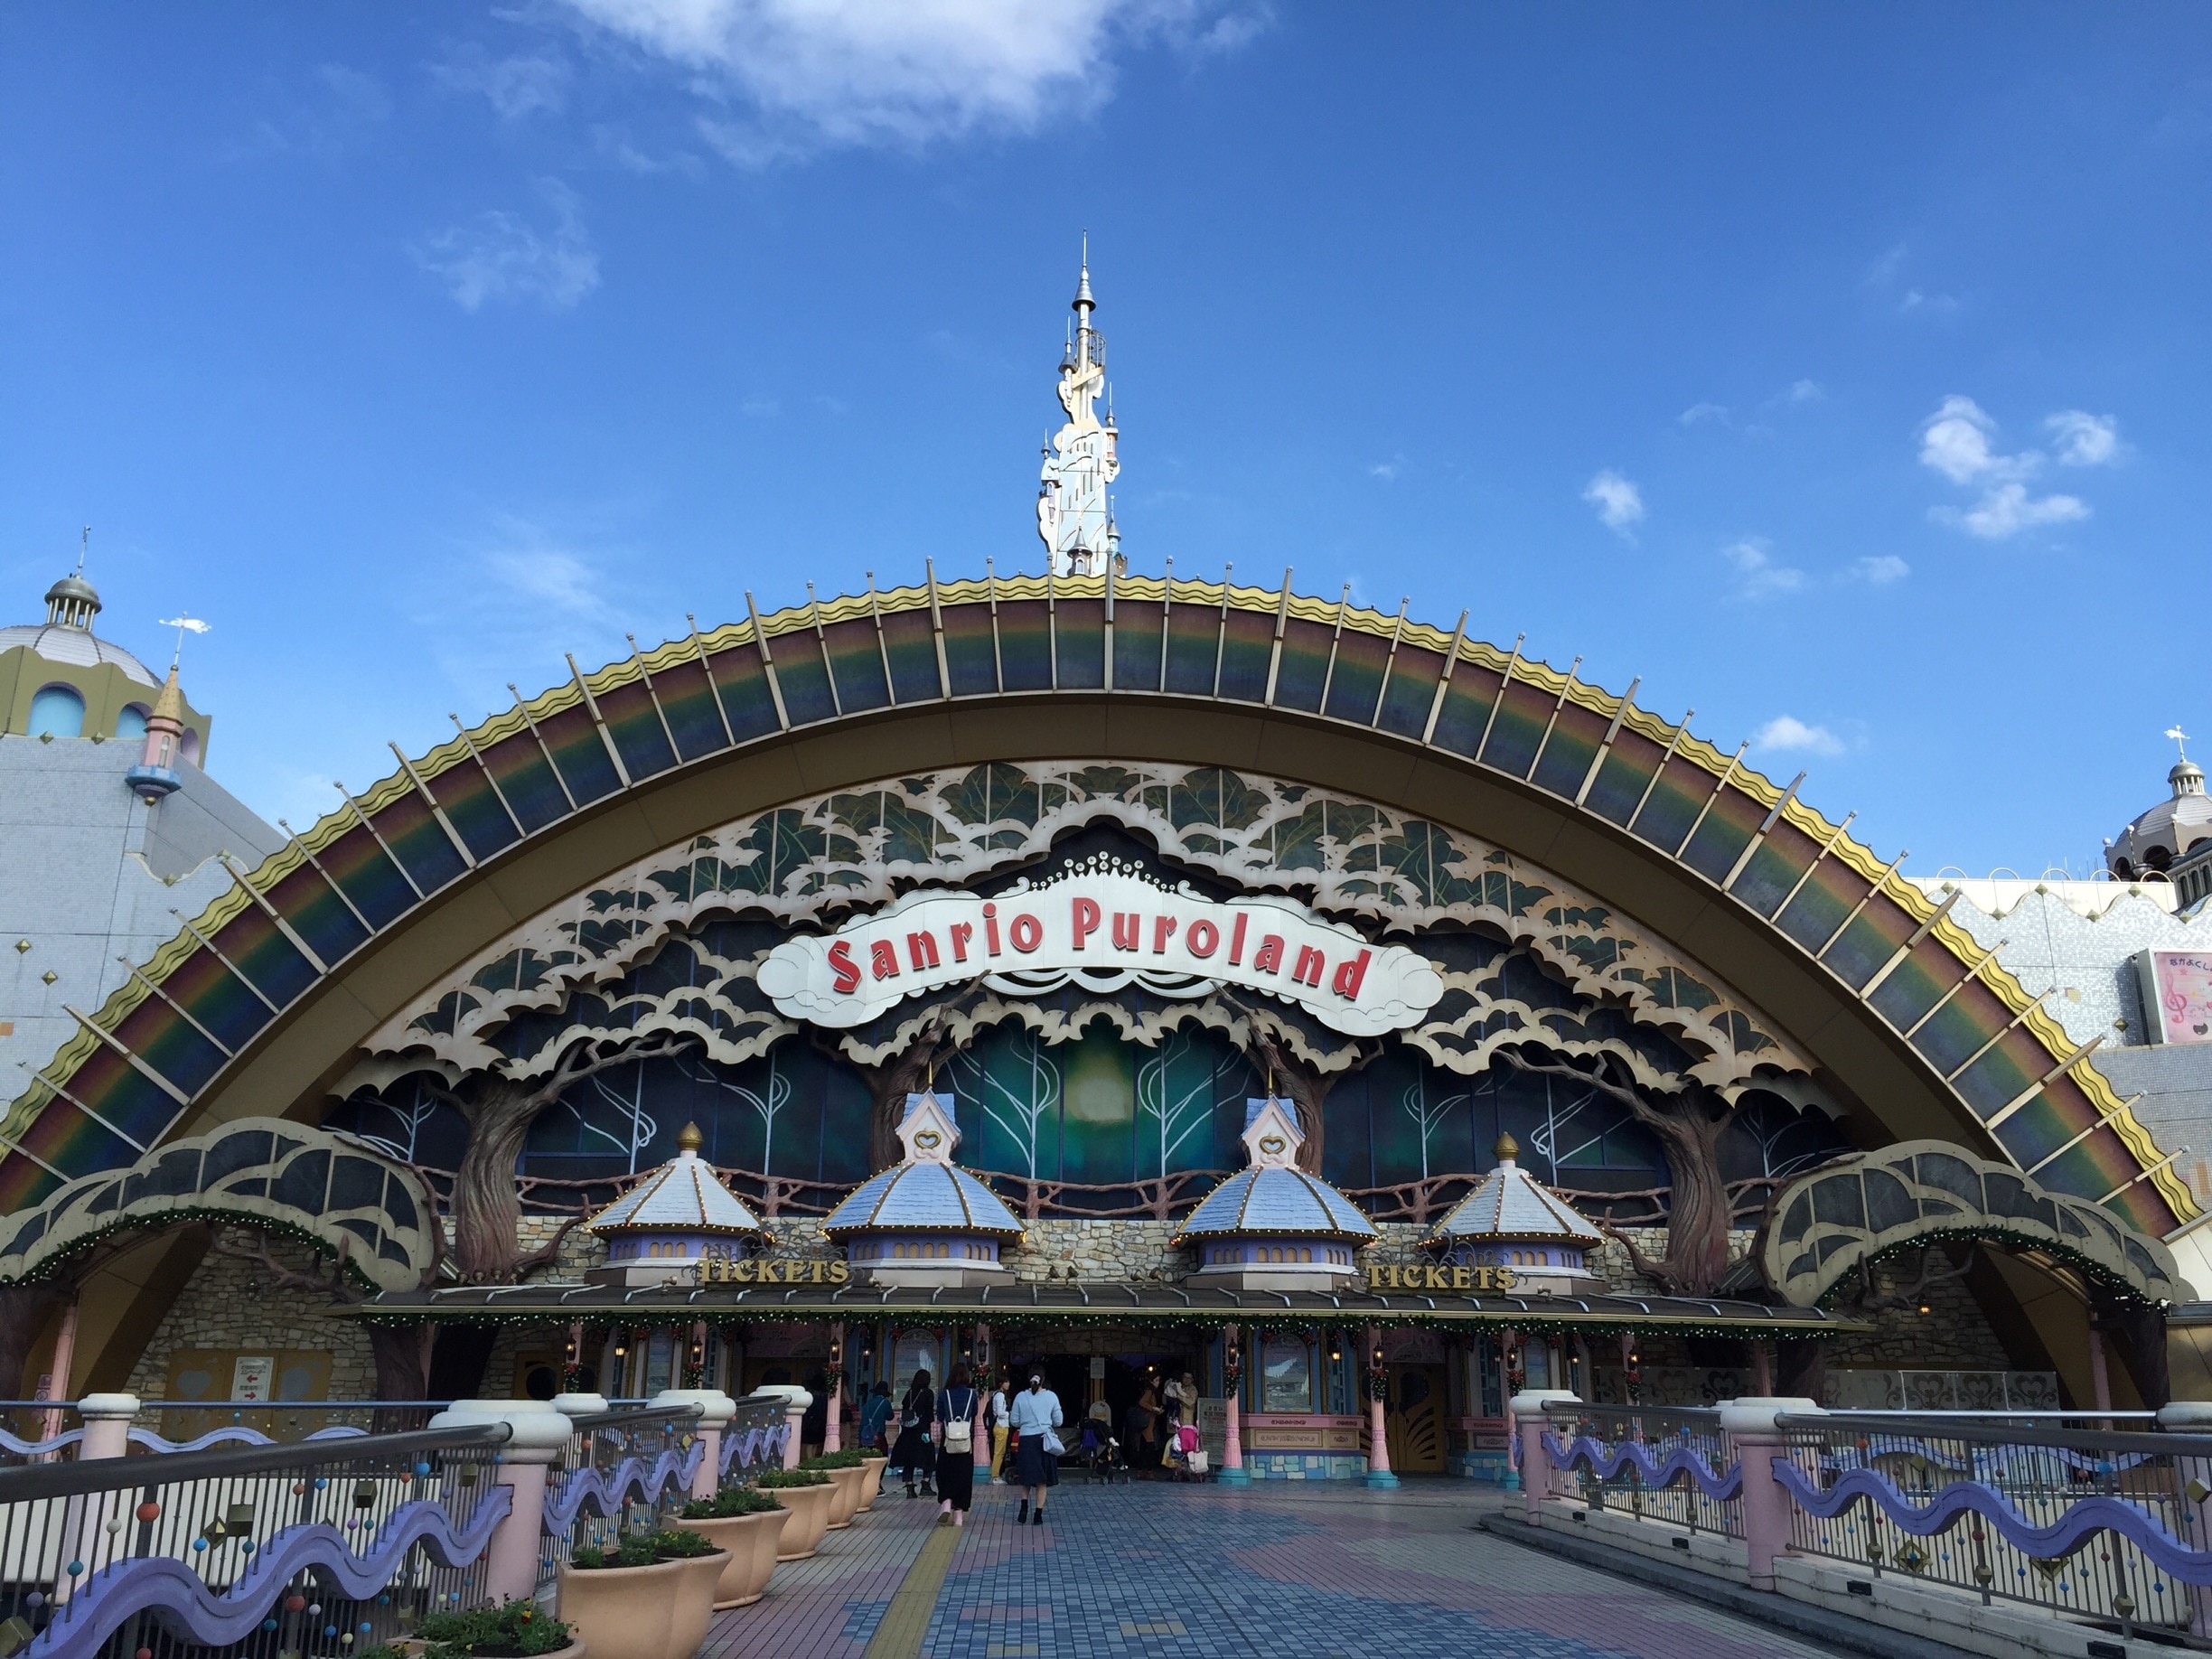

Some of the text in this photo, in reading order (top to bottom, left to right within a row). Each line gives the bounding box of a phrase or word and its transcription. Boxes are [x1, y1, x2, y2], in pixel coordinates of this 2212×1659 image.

[828, 896, 1373, 1000] Sanrio Puroland
[2169, 958, 2212, 972] なかよくし
[698, 1260, 849, 1283] TICKETS
[1366, 1265, 1516, 1289] TICKETS
